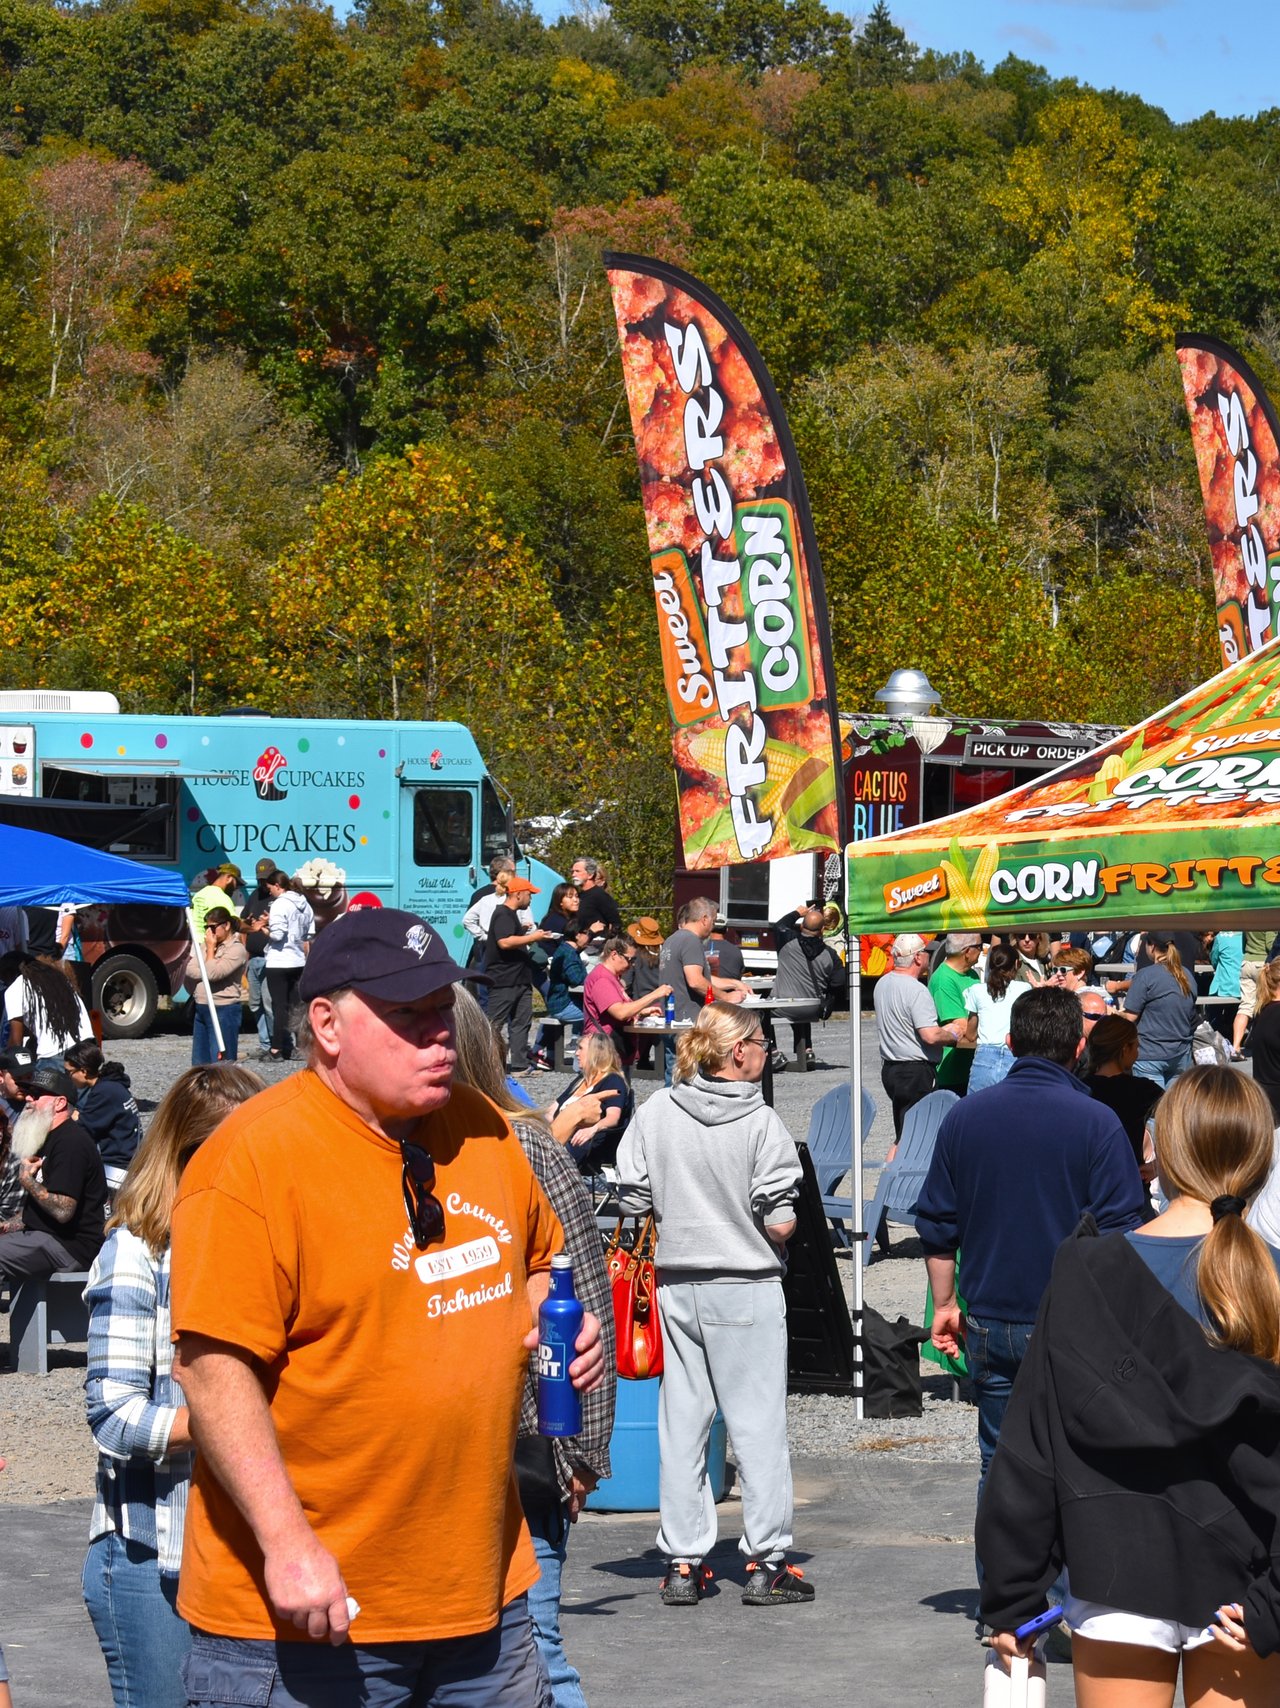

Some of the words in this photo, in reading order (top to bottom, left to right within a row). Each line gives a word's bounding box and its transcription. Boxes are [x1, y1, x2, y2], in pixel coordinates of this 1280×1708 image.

[663, 322, 774, 860] FRITTERS
[741, 515, 801, 692] CORN
[407, 757, 428, 765] HOUSE
[973, 742, 1006, 757] PICK
[1010, 743, 1029, 757] UP
[254, 753, 281, 796] of
[276, 770, 366, 788] CUPCAKES
[854, 770, 907, 802] CACTUS
[196, 823, 357, 852] CUPCAKES
[418, 878, 438, 888] Visit
[888, 873, 940, 909] Sweet
[988, 859, 1098, 904] CORN
[447, 1192, 513, 1244] County
[427, 1257, 454, 1275] EST
[462, 1244, 493, 1266] 1959
[426, 1272, 513, 1319] Technical
